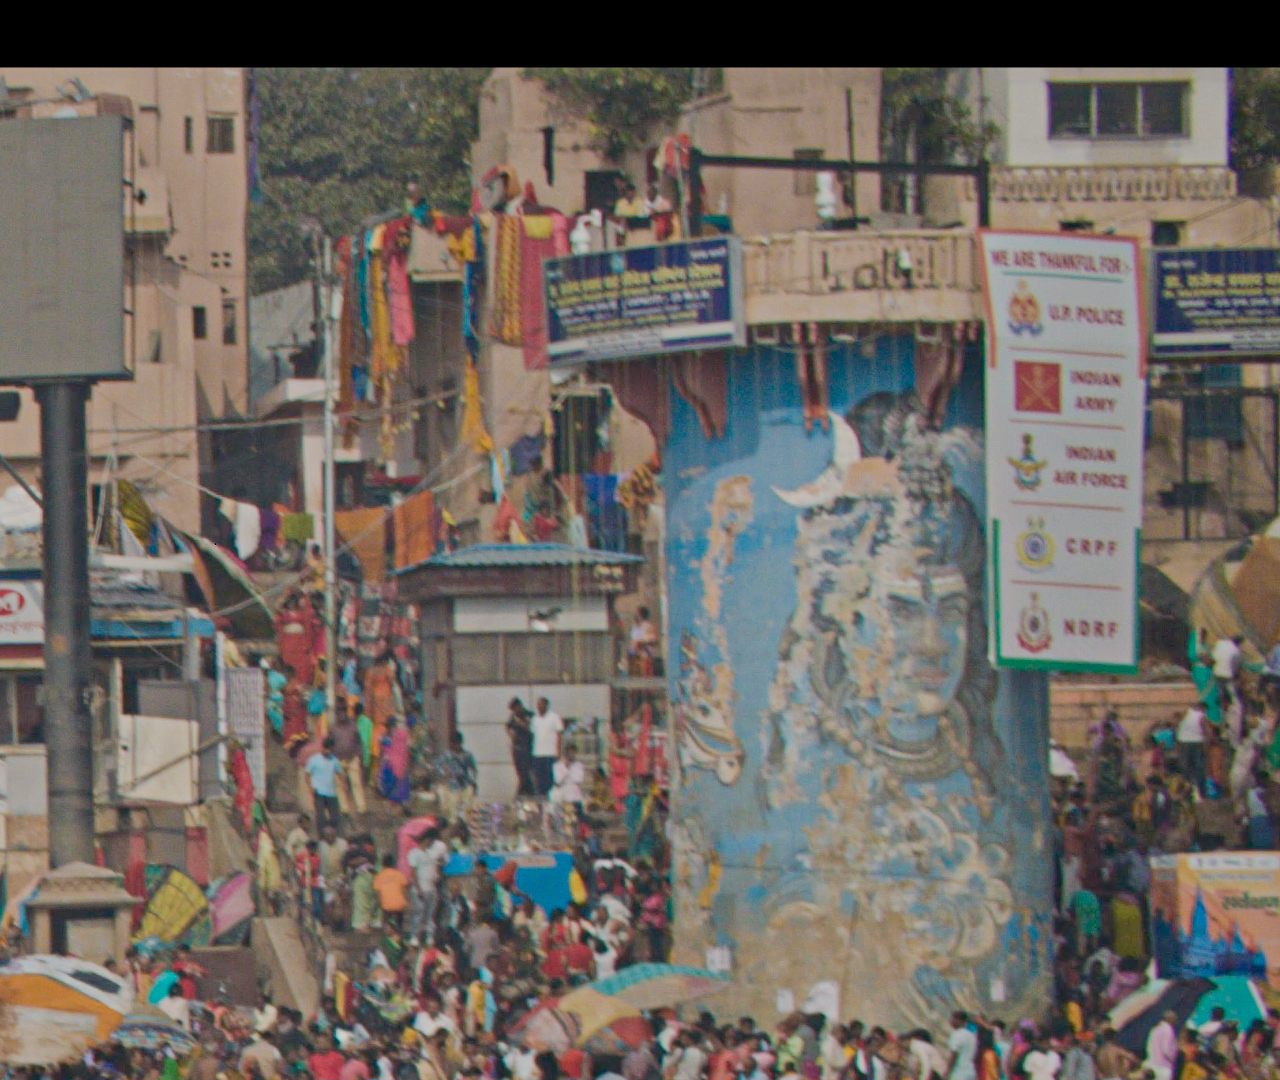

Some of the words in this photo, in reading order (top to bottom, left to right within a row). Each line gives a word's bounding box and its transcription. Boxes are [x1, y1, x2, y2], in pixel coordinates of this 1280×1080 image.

[991, 250, 1009, 267] WE
[1013, 250, 1036, 269] ARE
[1038, 251, 1097, 273] THANKFUL
[1099, 255, 1121, 274] FOR
[1049, 304, 1073, 321] U.P.
[1076, 306, 1124, 326] POLICE
[1071, 370, 1123, 388] INDIAN
[1075, 395, 1116, 412] ARMY
[1065, 446, 1117, 462] INDIAN
[1053, 470, 1078, 485] AIR
[1082, 472, 1128, 489] FORCE
